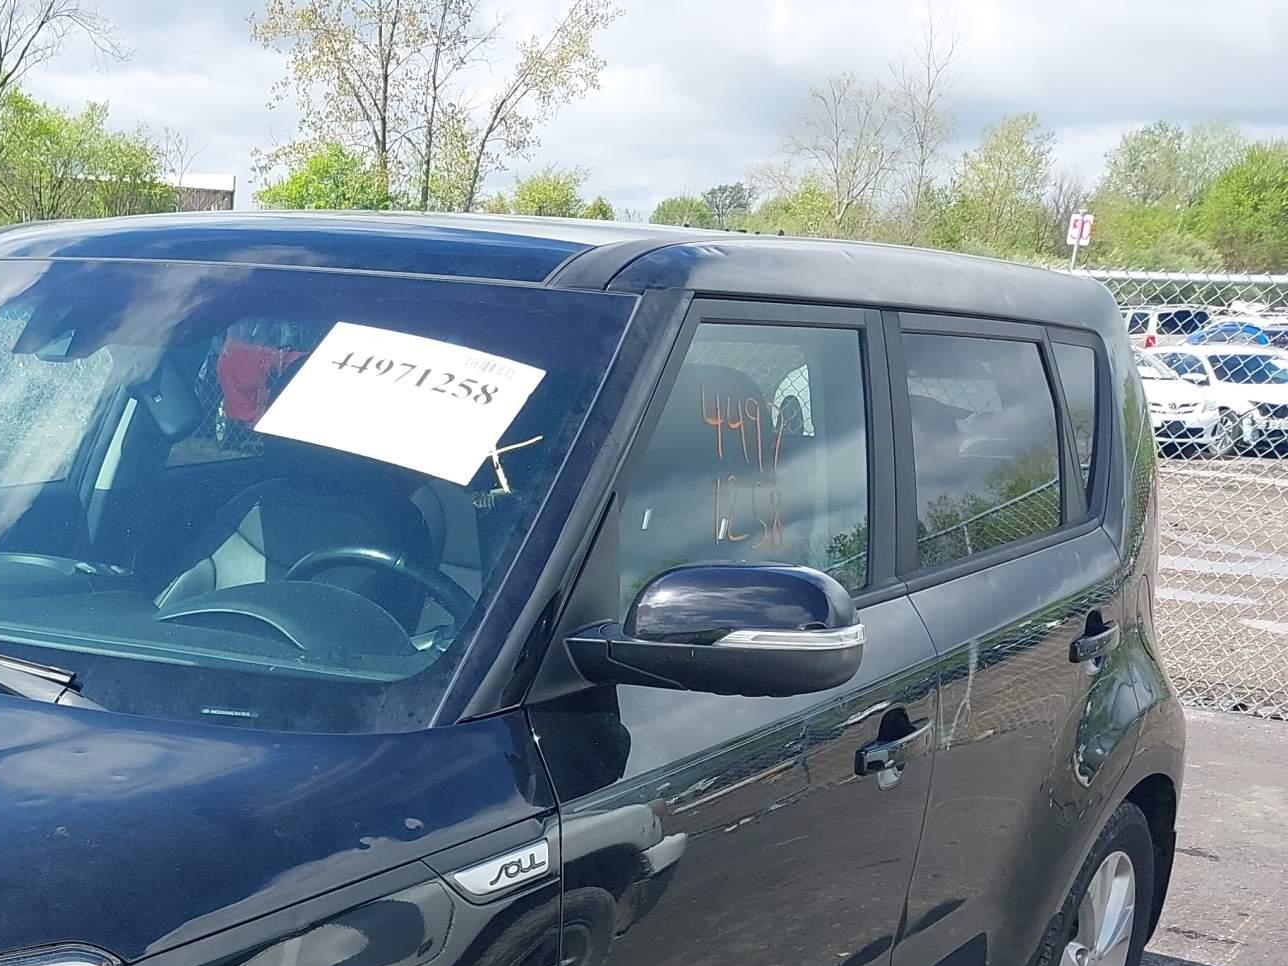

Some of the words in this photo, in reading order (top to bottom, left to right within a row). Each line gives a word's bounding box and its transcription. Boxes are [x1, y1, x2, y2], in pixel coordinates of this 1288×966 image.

[330, 351, 499, 405] 44971258
[699, 383, 785, 477] 4497
[714, 474, 783, 555] 1258
